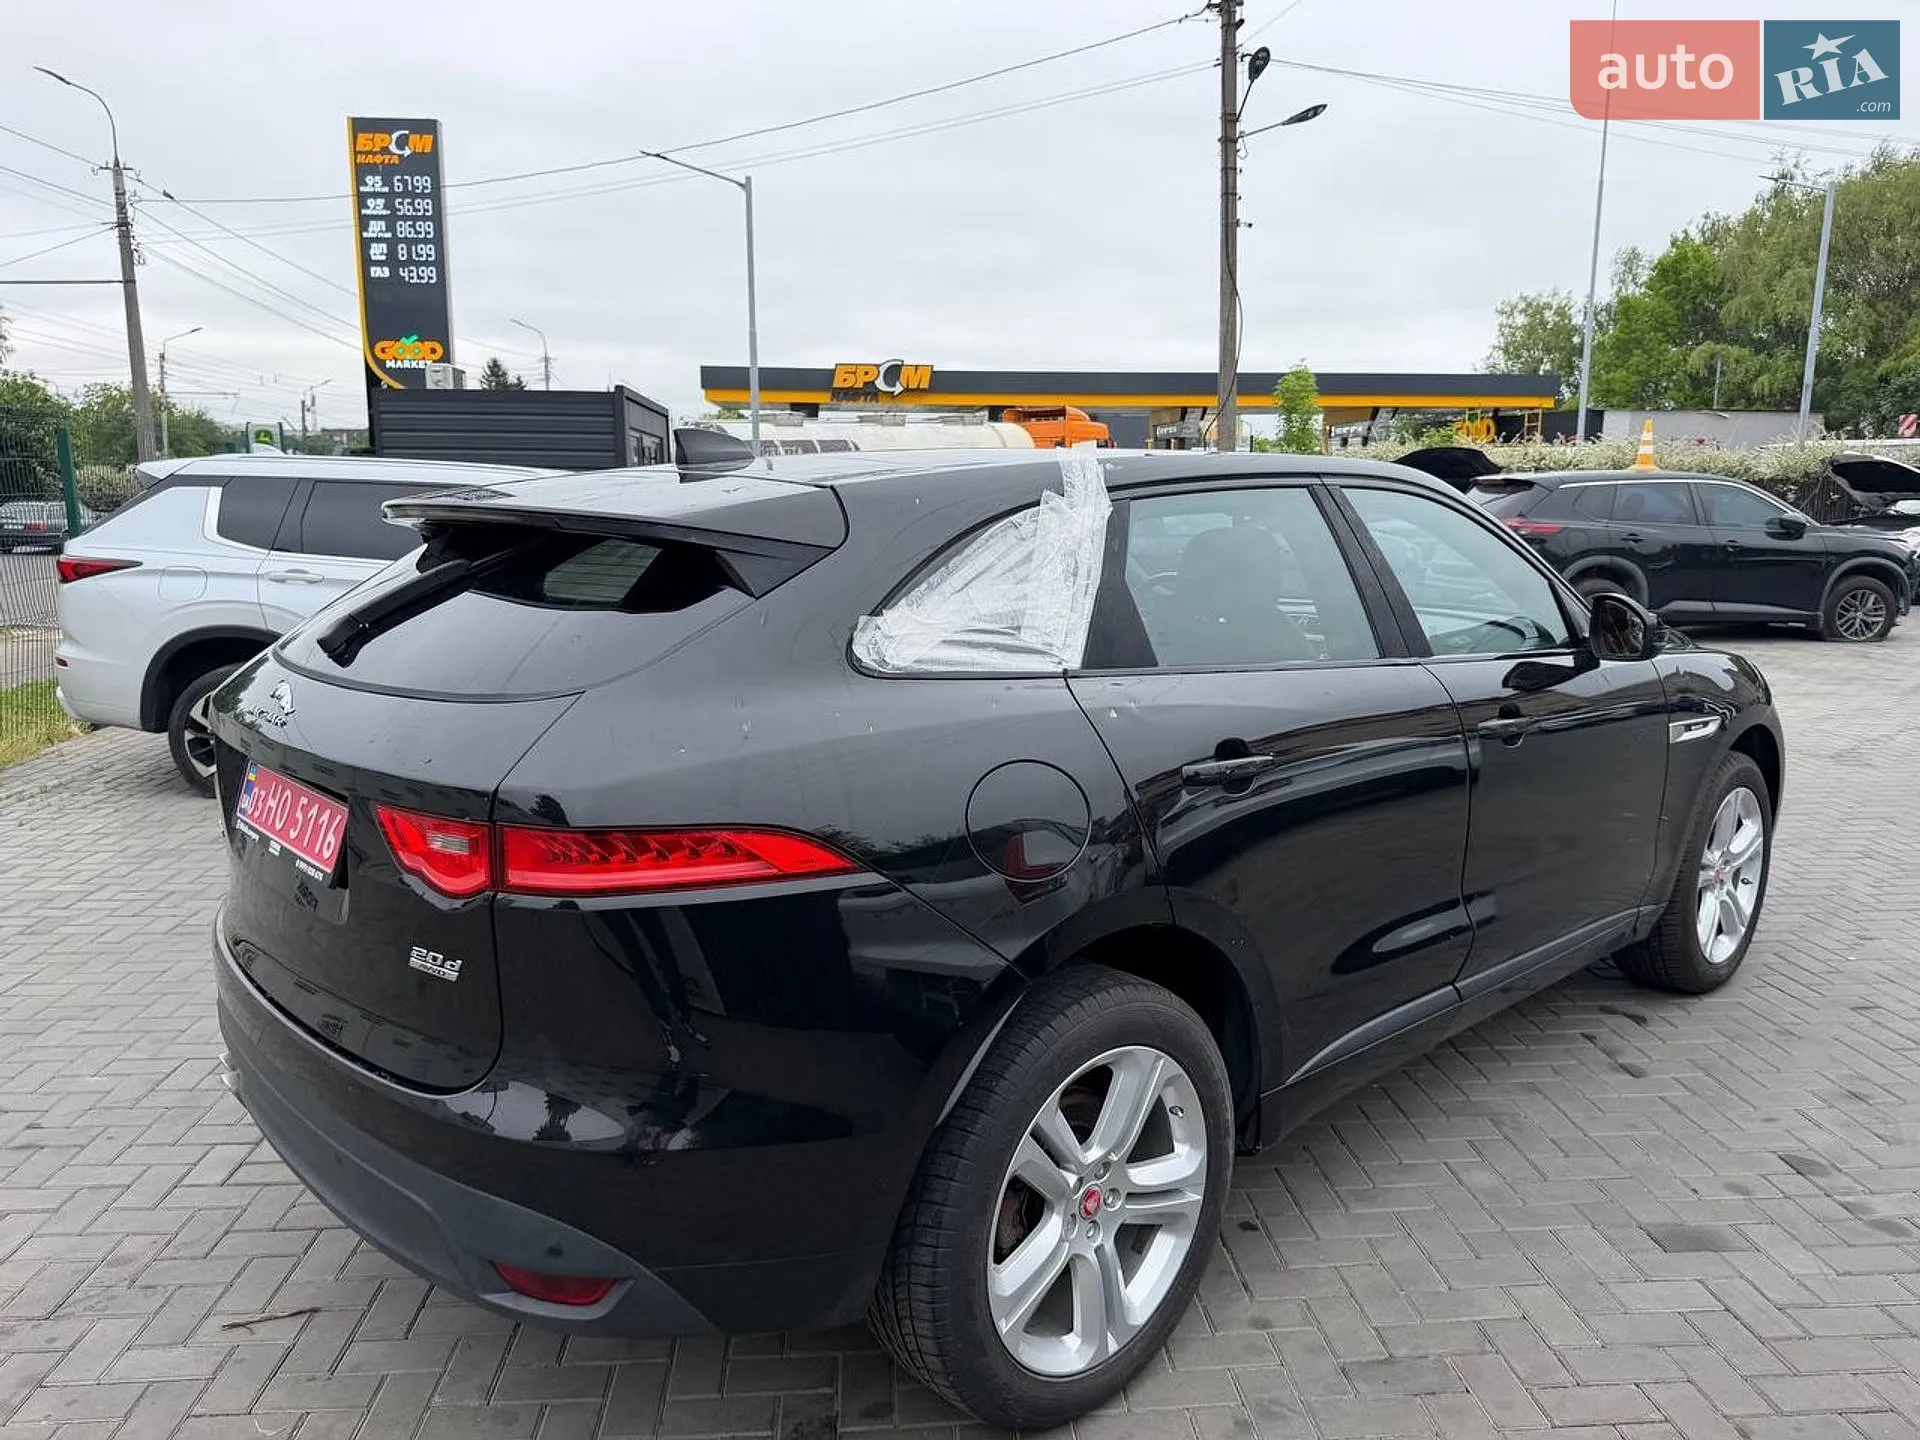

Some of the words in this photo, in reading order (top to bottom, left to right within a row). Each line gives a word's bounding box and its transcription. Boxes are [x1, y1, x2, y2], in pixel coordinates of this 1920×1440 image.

[365, 176, 383, 188] 95
[395, 199, 433, 216] 56.99
[396, 221, 434, 238] 86.99
[370, 266, 390, 278] ГАЗ
[399, 266, 437, 284] 43.99
[374, 340, 444, 361] GOOD
[289, 796, 342, 860] 5116
